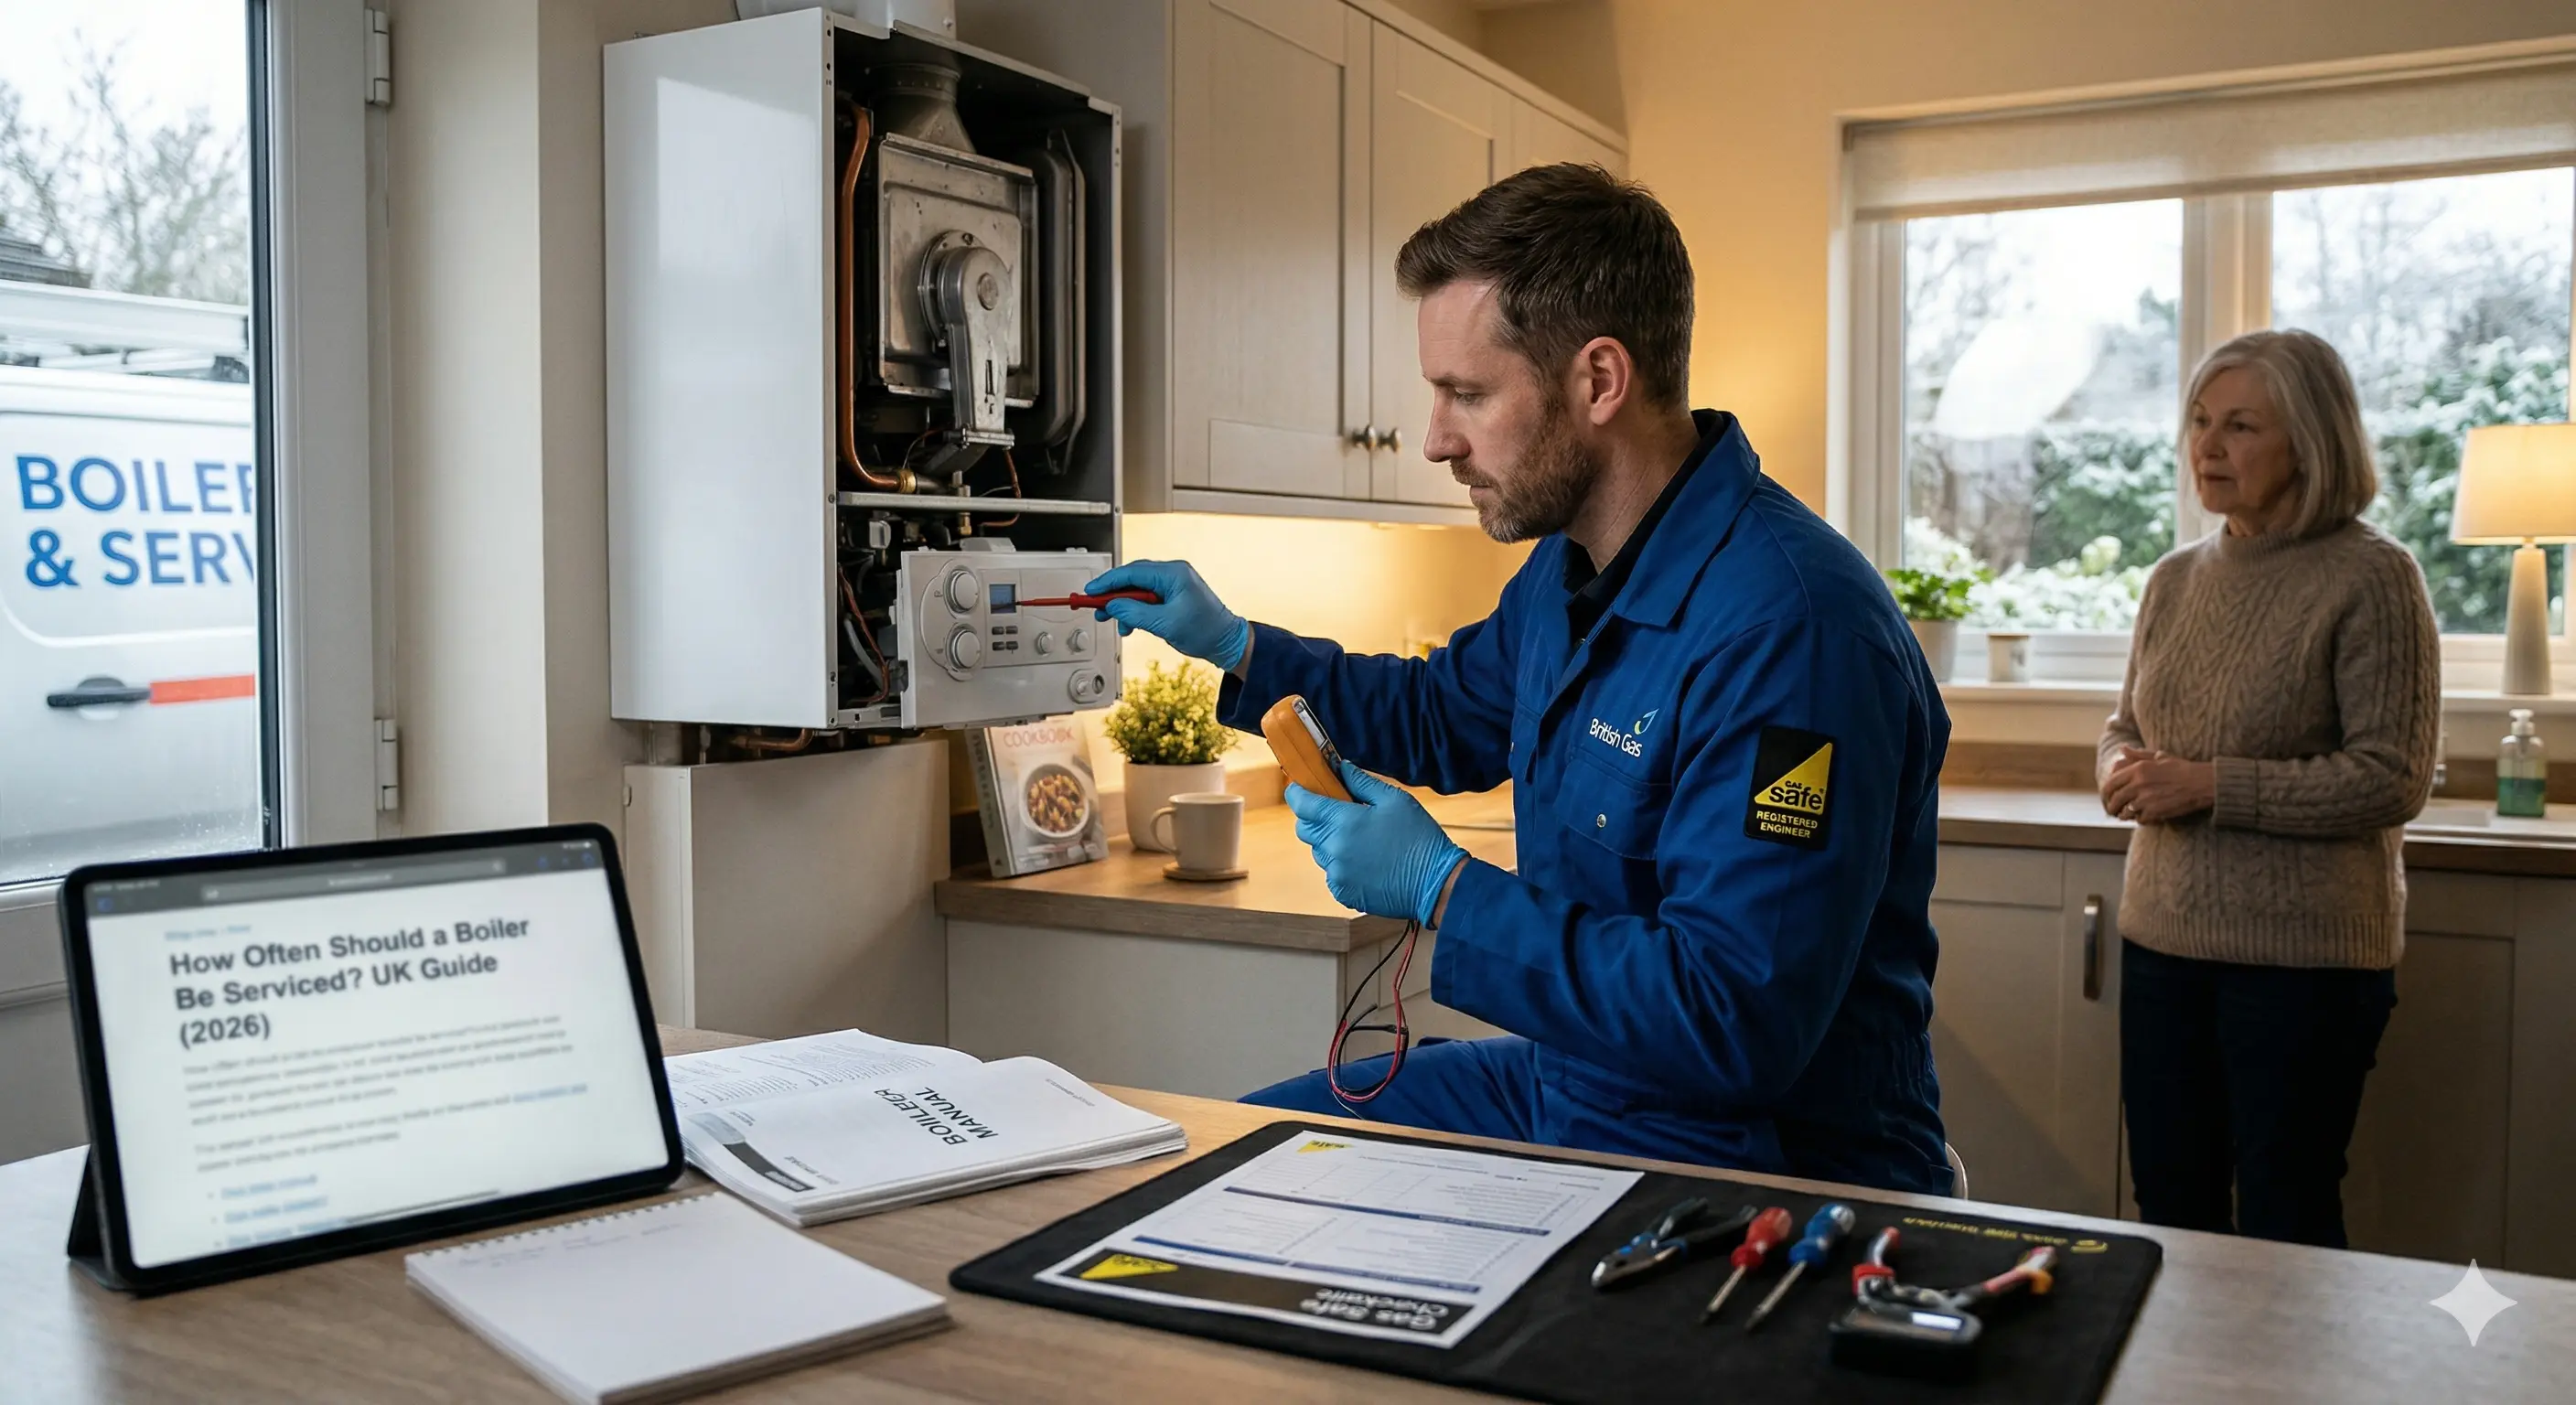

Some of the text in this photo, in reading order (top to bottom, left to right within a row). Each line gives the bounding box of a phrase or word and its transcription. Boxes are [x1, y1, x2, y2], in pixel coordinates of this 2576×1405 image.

[26, 530, 79, 587] &
[1589, 717, 1643, 757] British Gas
[1755, 810, 1819, 829] REGISTERED
[1760, 821, 1810, 839] ENGINEER
[169, 917, 530, 977] How Often Should a Boiler
[175, 952, 498, 1010] Be Serviced? UK Guide
[179, 1013, 271, 1050] (2026)
[915, 1087, 999, 1139] MANUAL
